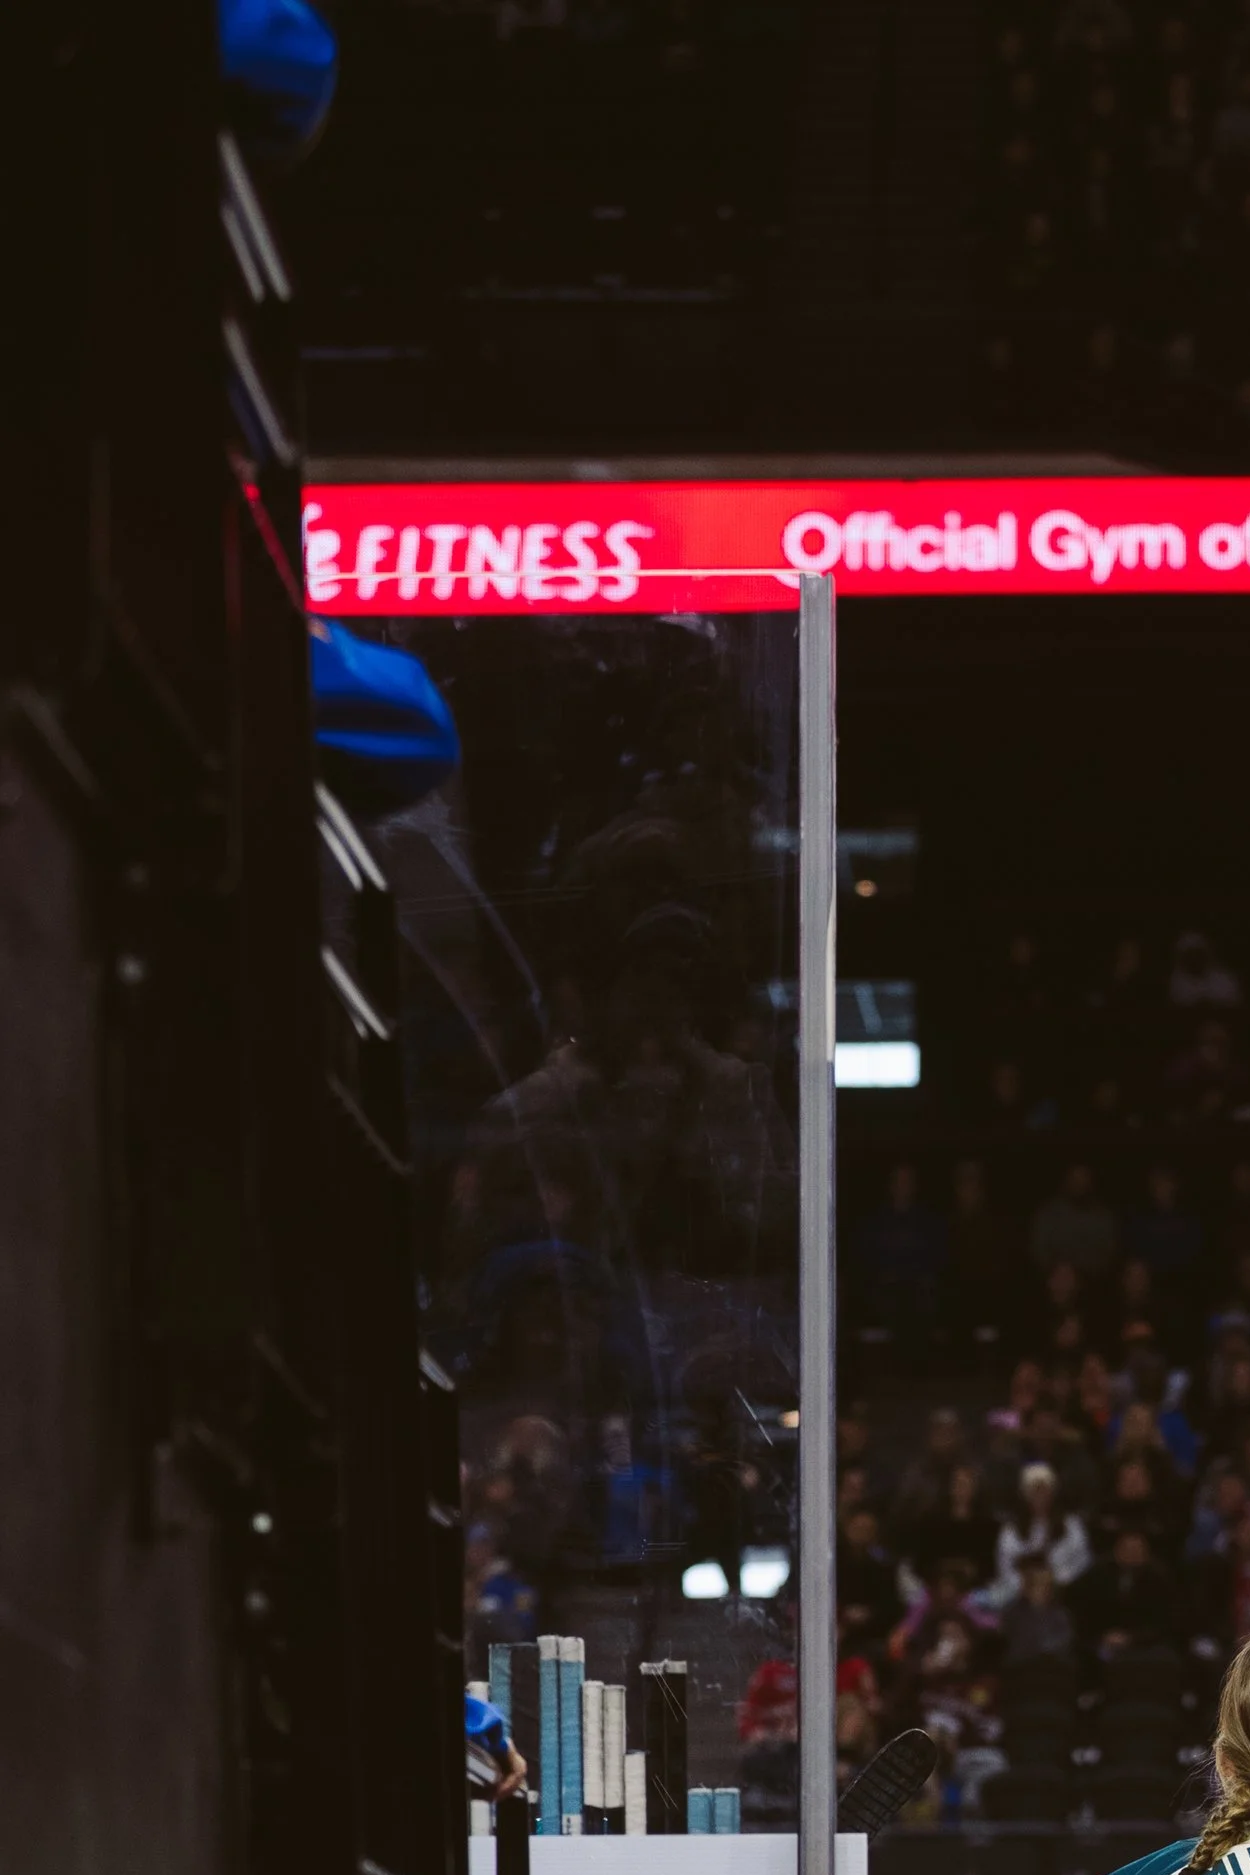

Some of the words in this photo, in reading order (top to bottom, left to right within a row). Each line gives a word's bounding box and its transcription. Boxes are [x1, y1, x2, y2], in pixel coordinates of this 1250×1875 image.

[355, 521, 655, 602] FITNESS
[782, 510, 1018, 573] Official
[1029, 509, 1187, 585] Gym
